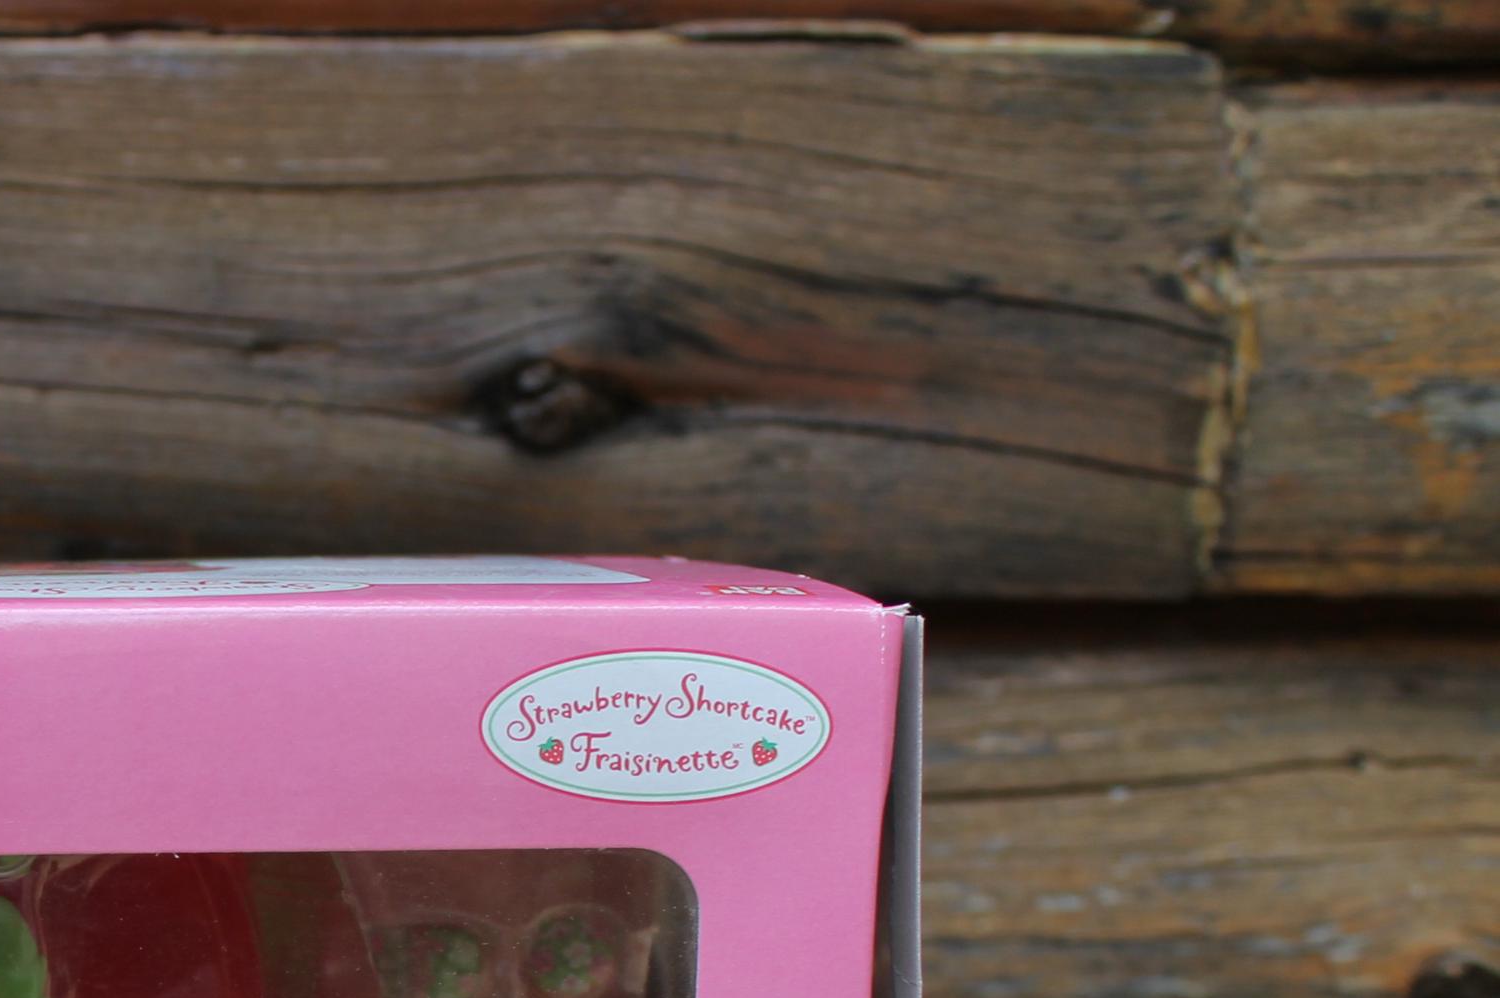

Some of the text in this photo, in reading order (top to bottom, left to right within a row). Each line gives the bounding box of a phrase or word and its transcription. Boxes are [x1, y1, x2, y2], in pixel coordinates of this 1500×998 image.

[506, 685, 663, 742] Strawberry
[664, 672, 806, 735] Shortcake
[569, 731, 740, 777] Fraisinette
